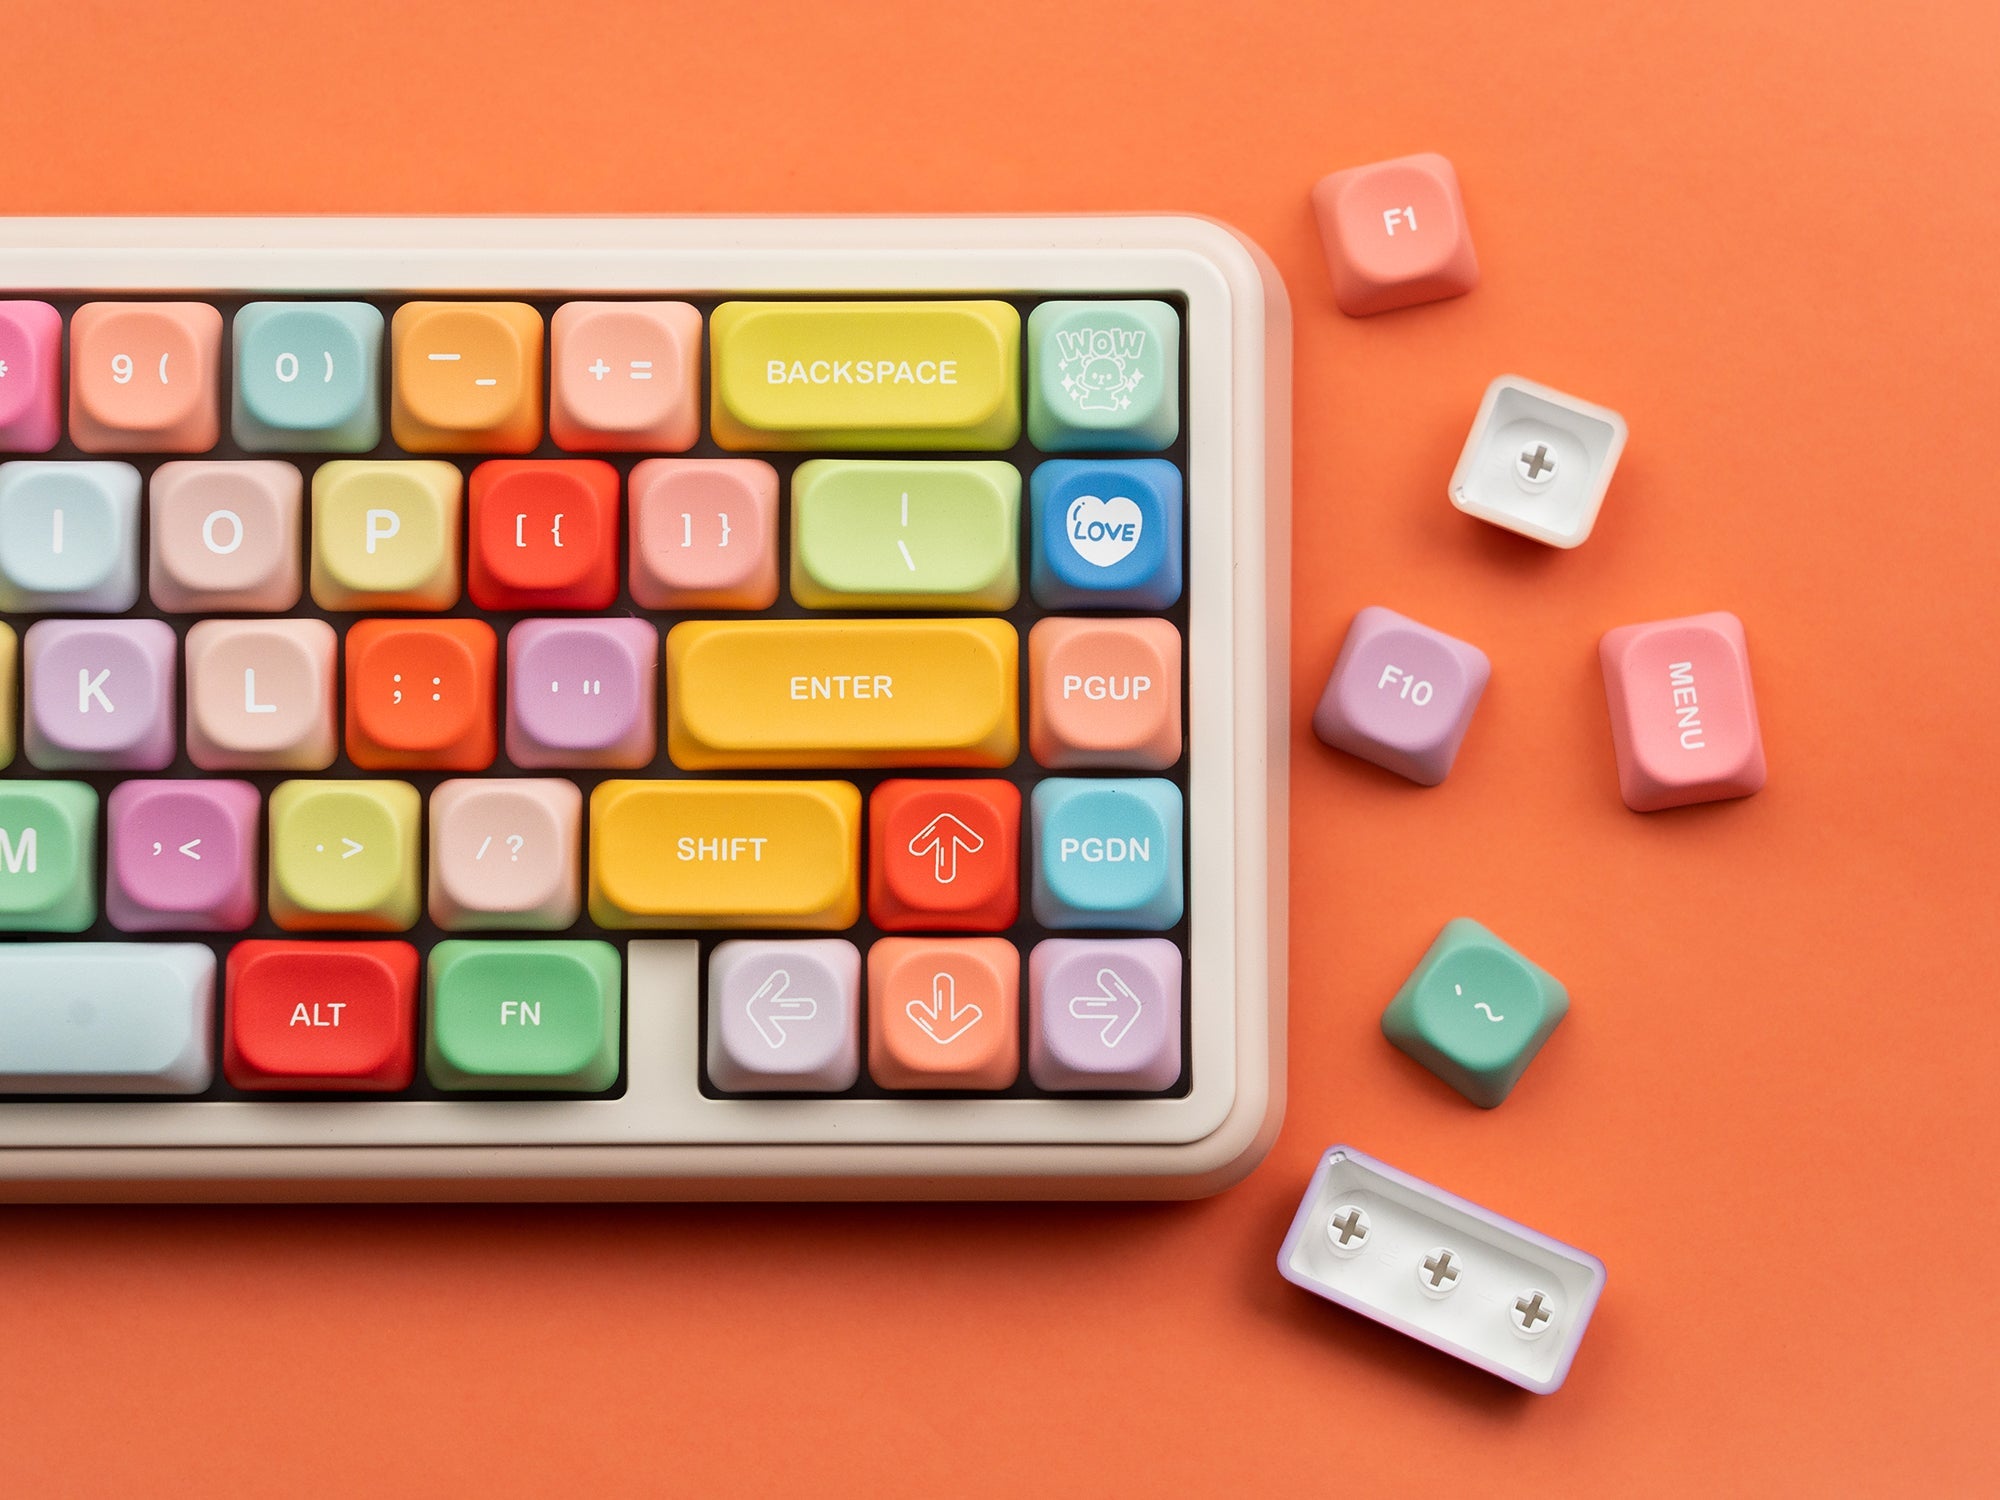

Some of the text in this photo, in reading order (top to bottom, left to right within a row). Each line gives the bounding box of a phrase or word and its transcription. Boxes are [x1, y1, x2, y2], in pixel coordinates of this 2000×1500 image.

[1383, 206, 1417, 236] F1
[1055, 326, 1147, 363] WOW
[111, 352, 169, 385] 9 (
[275, 351, 334, 383] 0 )
[588, 358, 653, 381] + =
[767, 360, 957, 385] BACKSPACE
[52, 509, 64, 554] I
[202, 509, 243, 555] O
[365, 509, 401, 554] P
[516, 513, 564, 547] [ {
[681, 513, 732, 548] ] }
[1073, 520, 1137, 543] LOVE
[897, 540, 916, 572] \
[78, 668, 115, 714] K
[244, 668, 277, 714] L
[393, 674, 441, 704] ; :
[790, 675, 893, 700] ENTER
[1063, 675, 1151, 701] PGUP
[1377, 664, 1433, 706] F10
[1669, 662, 1705, 750] MENU
[0, 827, 37, 874] M
[178, 838, 201, 860] <
[341, 837, 364, 859] >
[476, 834, 524, 862] / ?
[677, 837, 768, 861] SHIFT
[1061, 837, 1150, 863] PGDN
[289, 1002, 347, 1027] ALT
[500, 1001, 541, 1026] FN
[1474, 1002, 1505, 1022] ~
